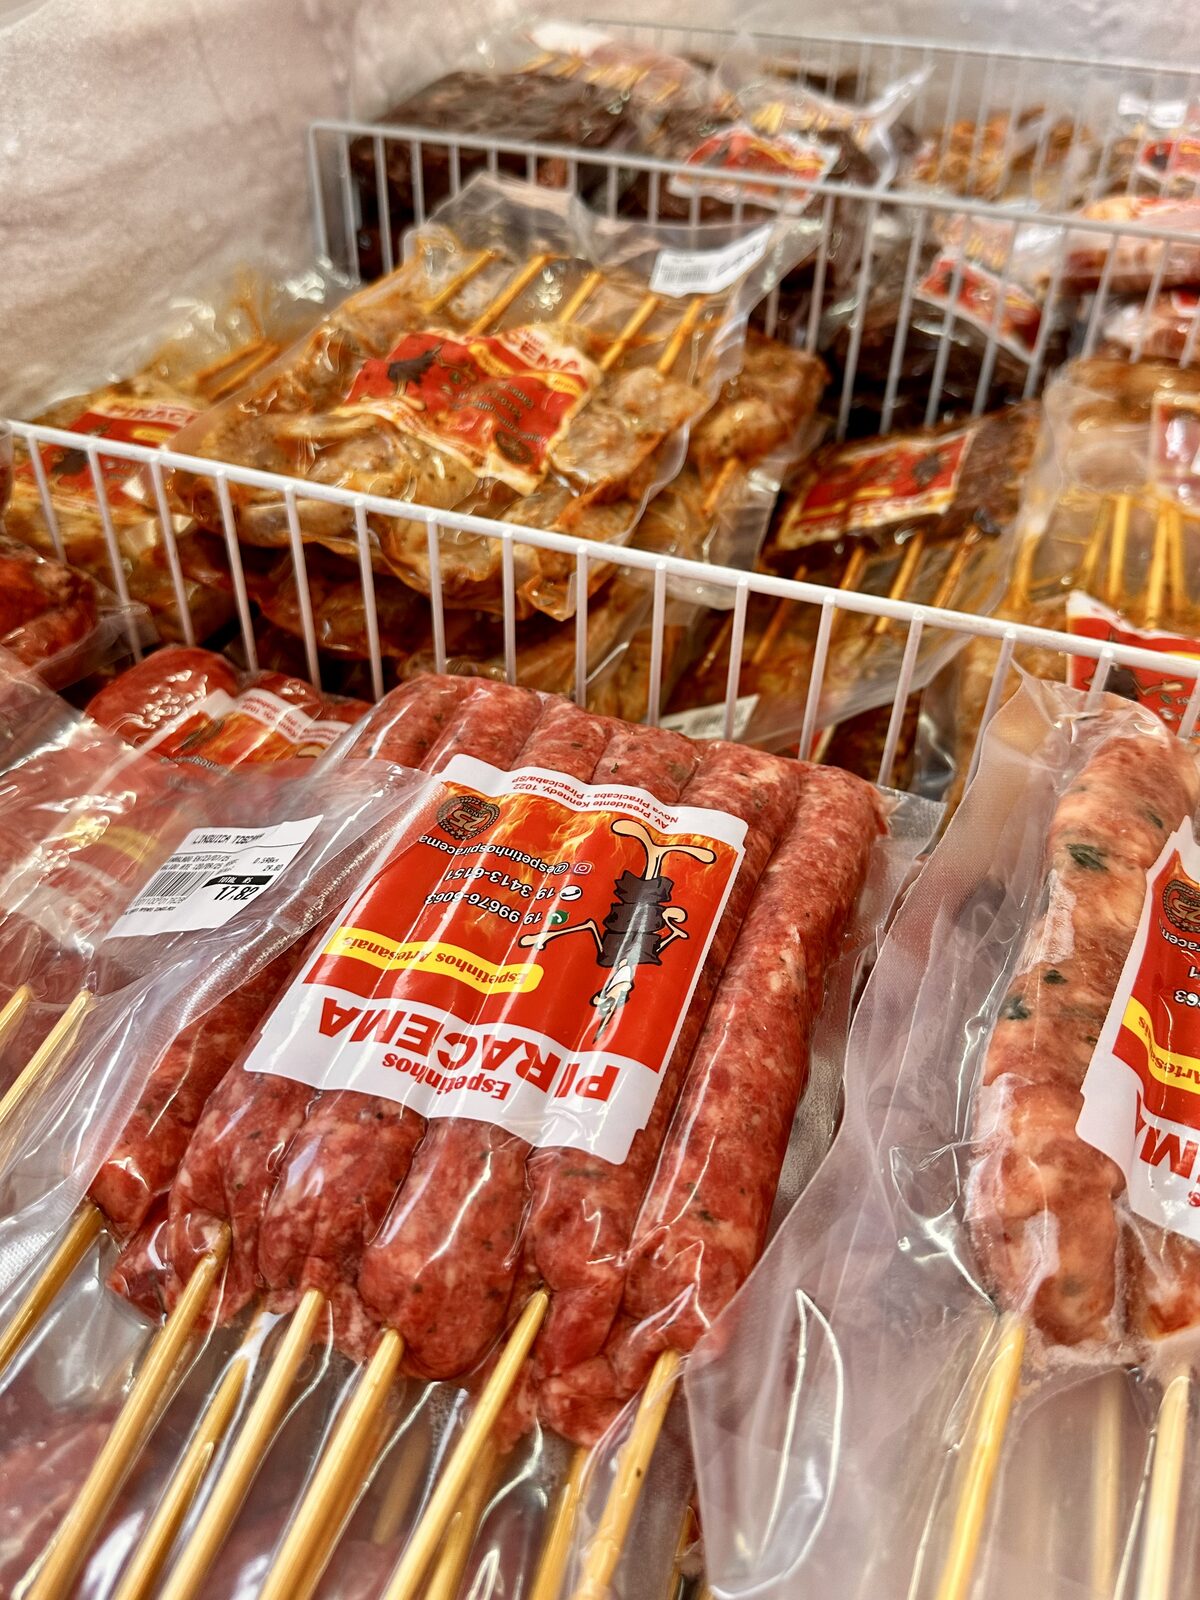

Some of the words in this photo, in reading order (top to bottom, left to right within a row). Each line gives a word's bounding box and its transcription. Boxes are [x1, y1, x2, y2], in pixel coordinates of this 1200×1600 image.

[512, 775, 586, 800] Piracicaba/SP
[513, 783, 538, 791] 1022
[593, 801, 652, 819] Presidente
[594, 793, 651, 810] Piracicaba
[452, 811, 489, 832] 25
[652, 808, 679, 824] Nova
[655, 817, 669, 830] Av.
[418, 835, 570, 876] @espetinhospiracema
[445, 868, 534, 899] 3413-6151
[213, 886, 260, 901] 17,82
[536, 887, 556, 900] 19
[523, 912, 543, 925] 19
[343, 936, 433, 962] Artesanais
[434, 952, 529, 985] Espetinhos
[319, 997, 620, 1102] PIRACEMA
[382, 1052, 512, 1101] Espetinhos
